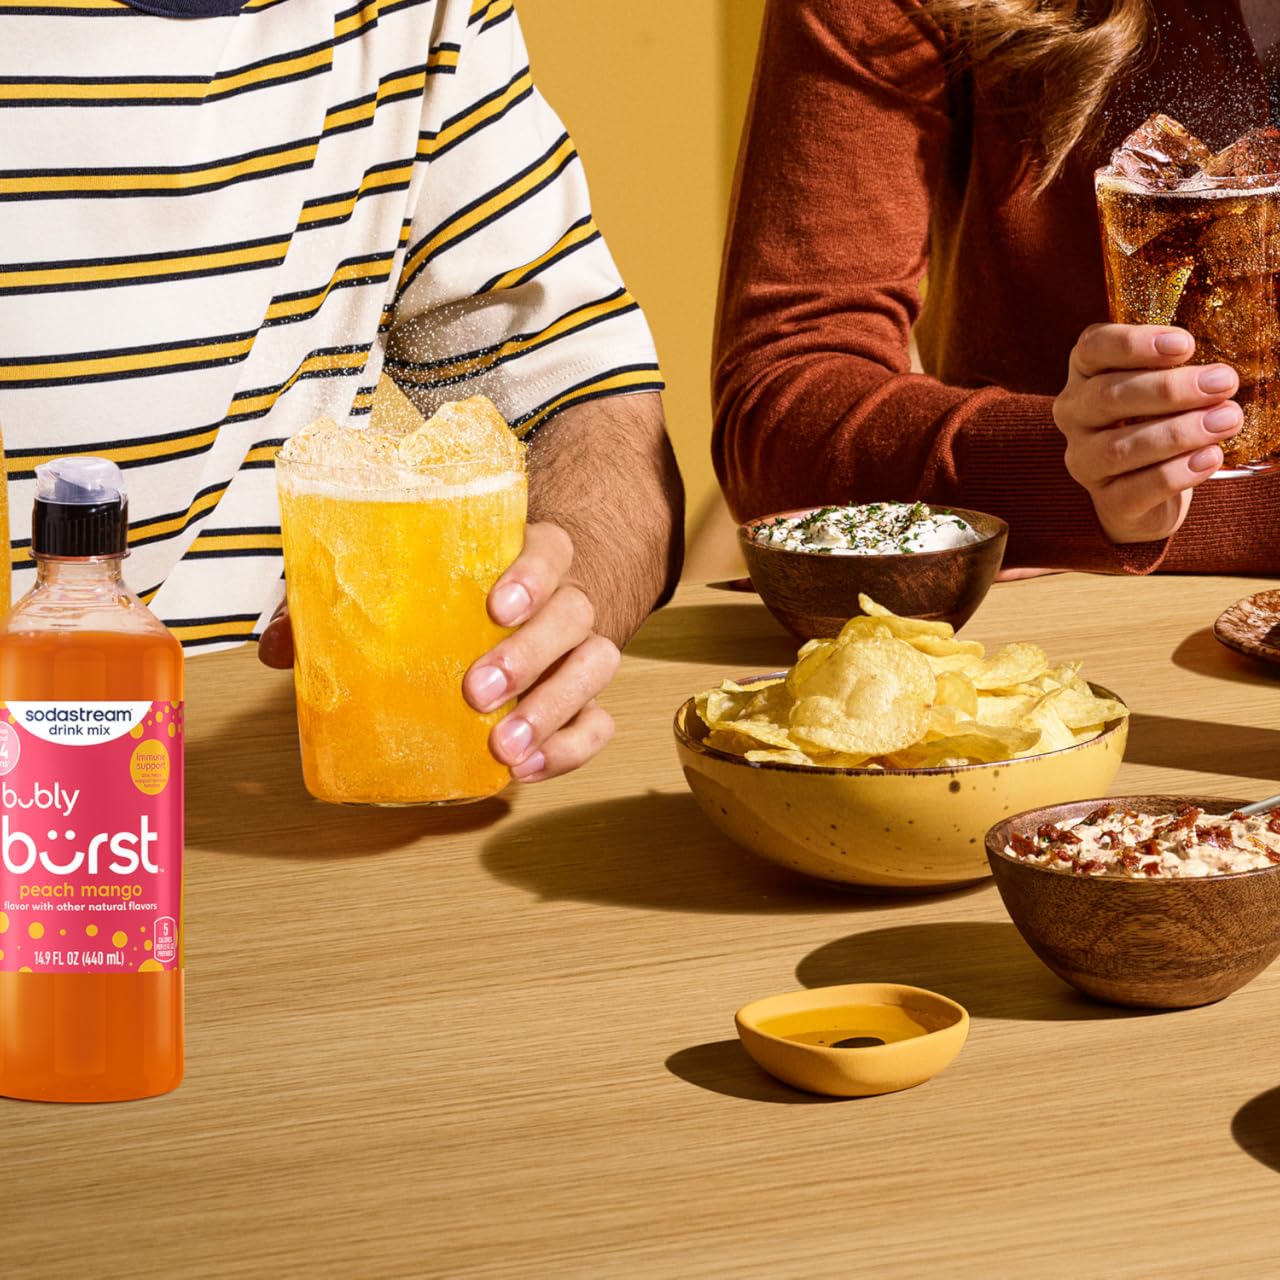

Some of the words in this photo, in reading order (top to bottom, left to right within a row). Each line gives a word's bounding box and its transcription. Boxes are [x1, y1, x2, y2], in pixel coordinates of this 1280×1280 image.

[25, 707, 133, 722] sodastream
[48, 724, 84, 736] drink
[87, 724, 111, 736] mix
[136, 762, 166, 772] support
[19, 882, 74, 900] peach
[80, 884, 143, 901] mango
[3, 901, 30, 911] flavor
[31, 901, 54, 912] with
[56, 901, 86, 912] other
[88, 901, 127, 912] natural
[128, 900, 158, 911] flavors
[163, 922, 169, 936] 5
[34, 952, 50, 965] 14.9
[53, 952, 64, 965] FL
[66, 951, 79, 965] OZ
[82, 951, 104, 967] (440
[106, 951, 125, 967] mL)
